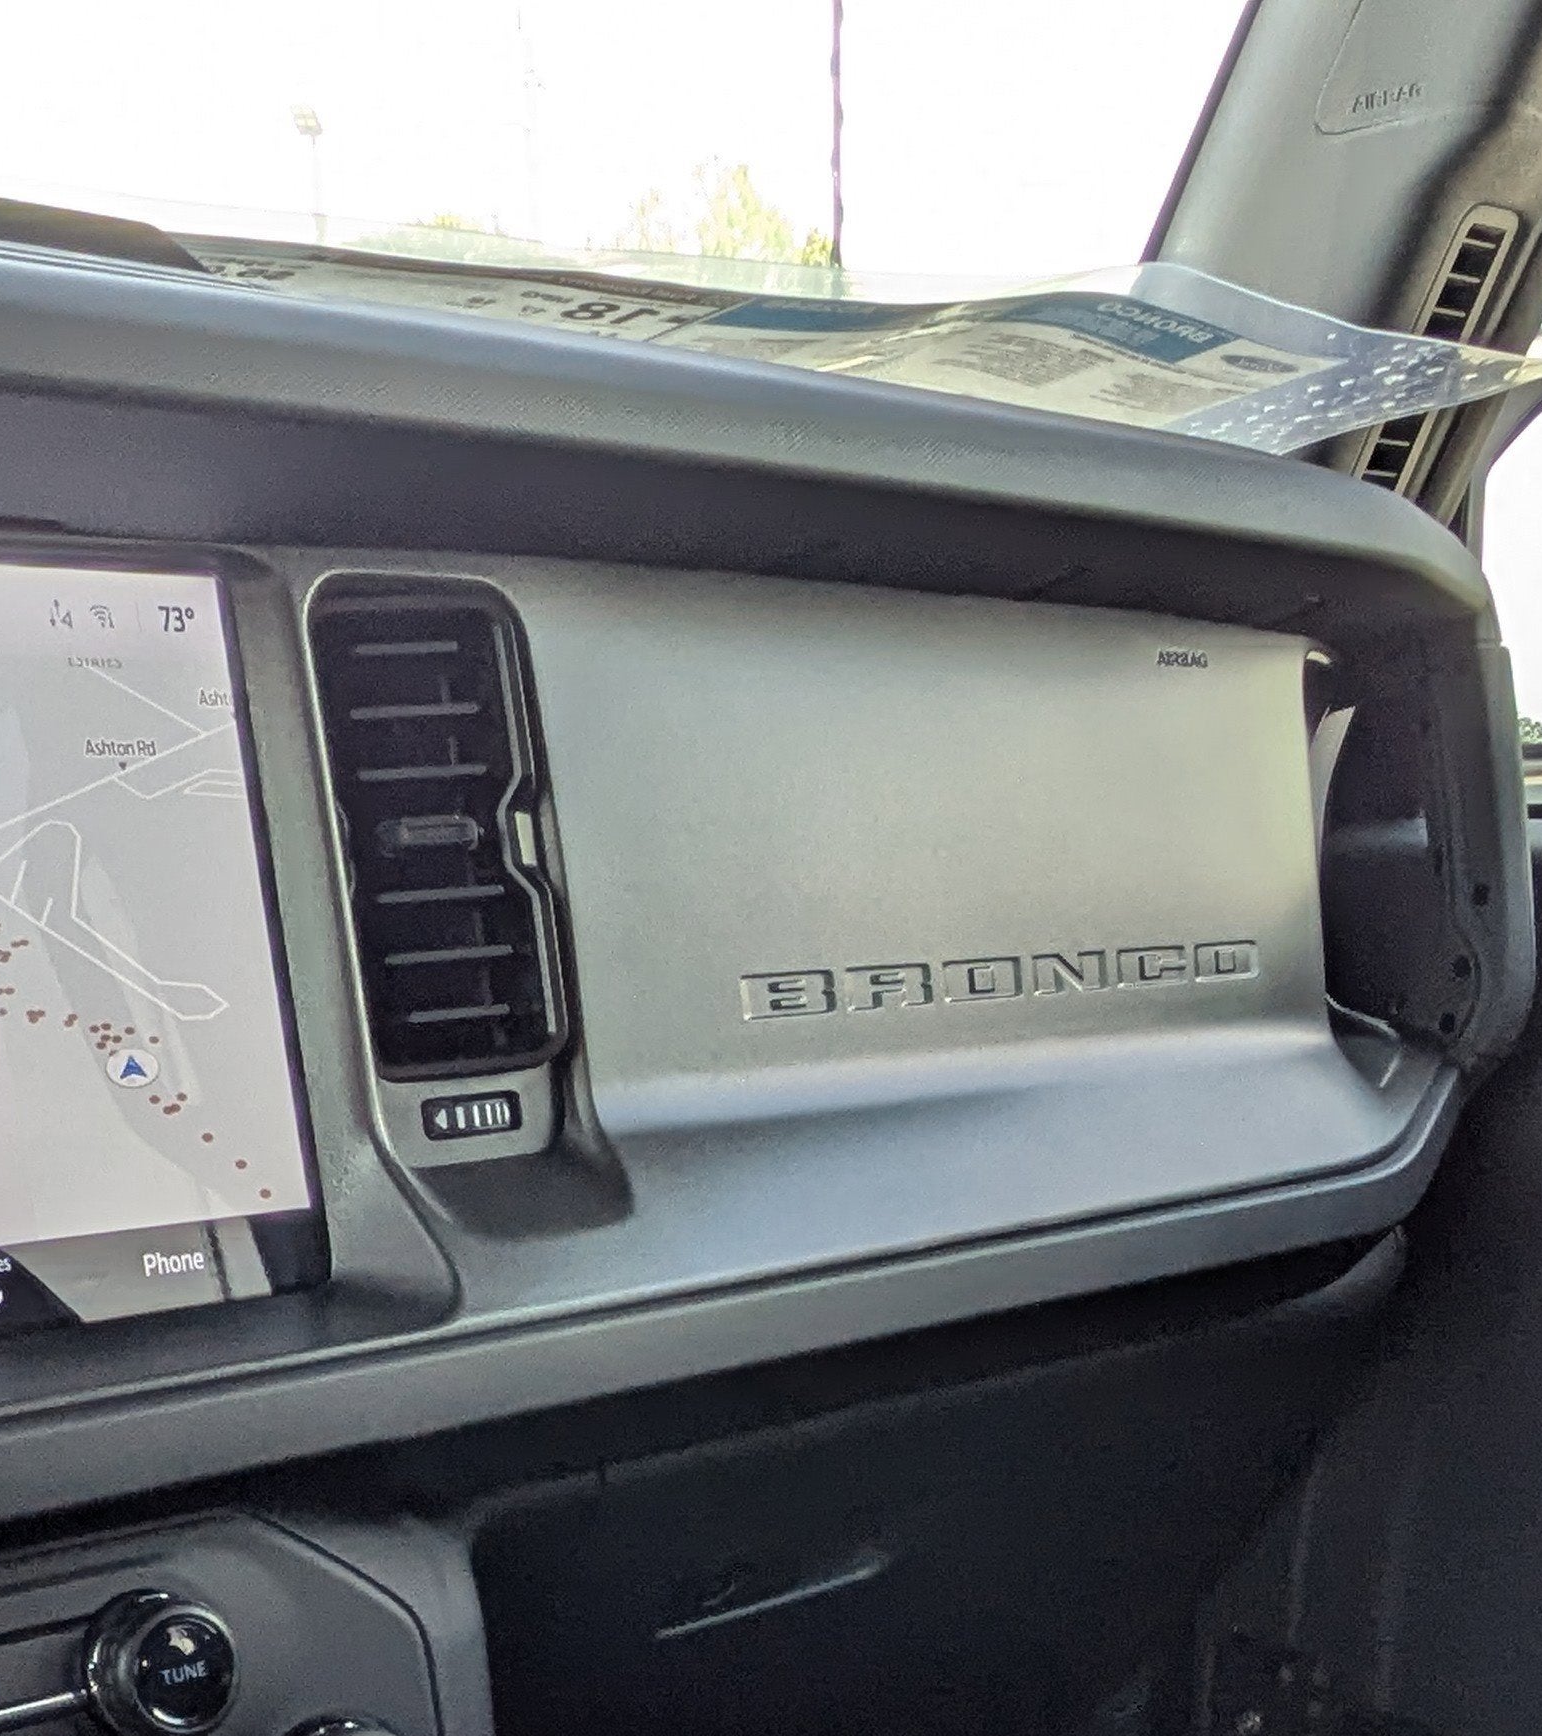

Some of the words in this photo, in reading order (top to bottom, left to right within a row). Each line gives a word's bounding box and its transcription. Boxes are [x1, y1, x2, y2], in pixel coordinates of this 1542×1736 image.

[159, 605, 195, 632] 73°
[85, 739, 135, 757] Ashton
[137, 740, 157, 757] Rd
[740, 938, 1261, 1022] BRONCO
[143, 1250, 204, 1277] Phone
[161, 1661, 208, 1687] TUNE
